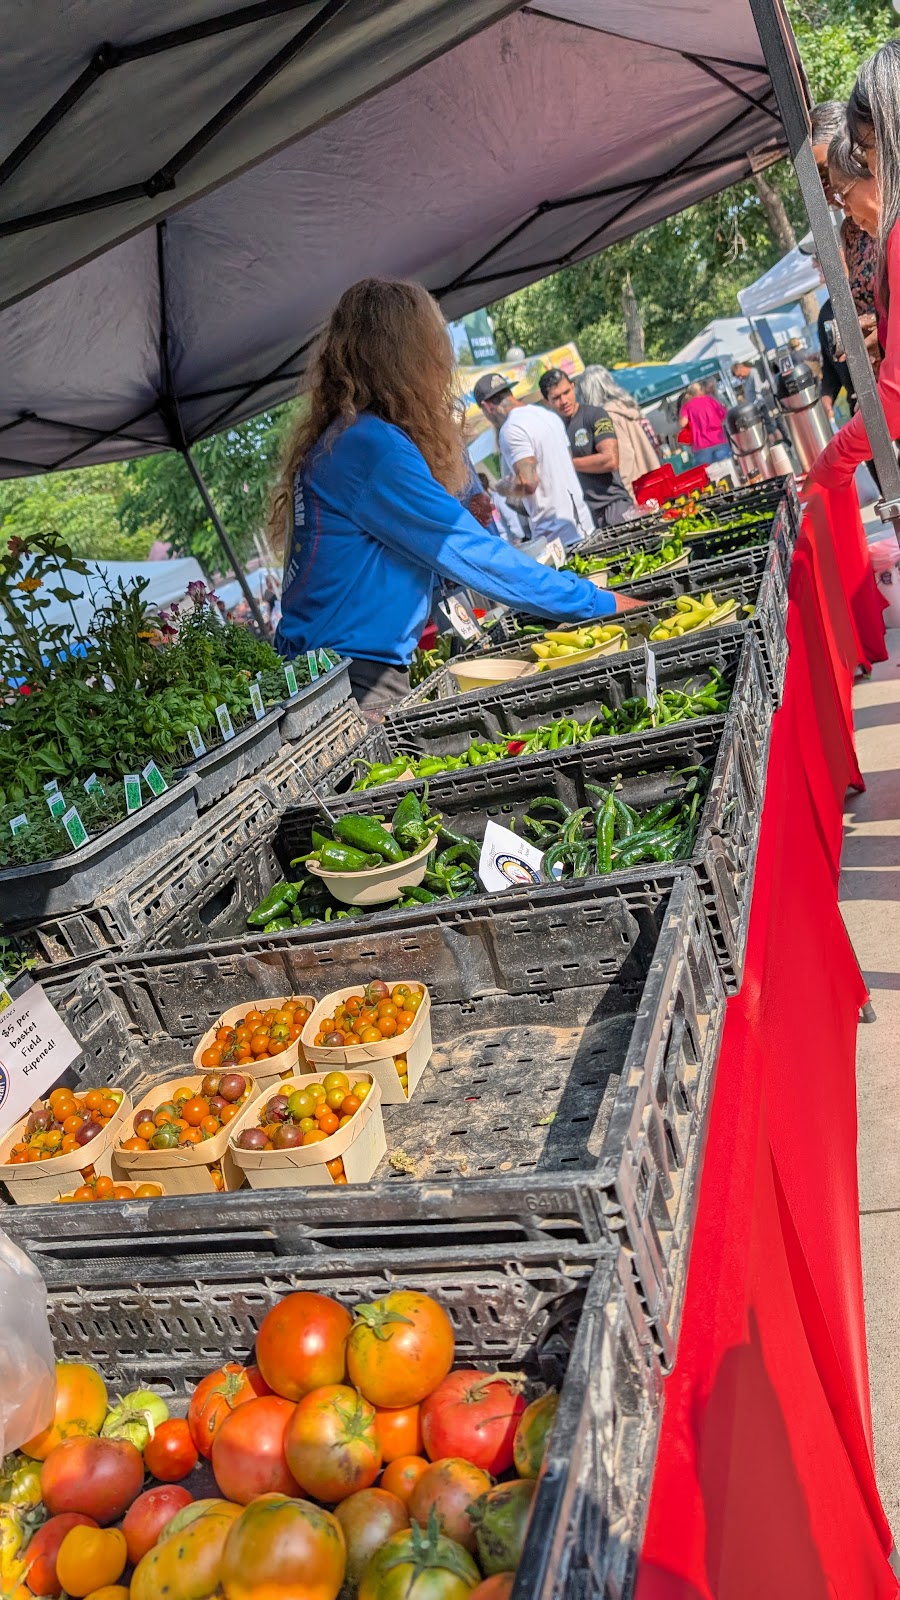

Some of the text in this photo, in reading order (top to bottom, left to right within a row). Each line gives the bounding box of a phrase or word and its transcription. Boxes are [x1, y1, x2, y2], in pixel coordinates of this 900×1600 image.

[1, 1010, 30, 1038] $5 per
[9, 1021, 37, 1049] basket
[20, 1034, 42, 1058] Field
[22, 1038, 57, 1077] Ripened!
[262, 1208, 303, 1220] RECYCLED
[304, 1206, 349, 1218] MATERIALS
[525, 1193, 574, 1211] 6411
